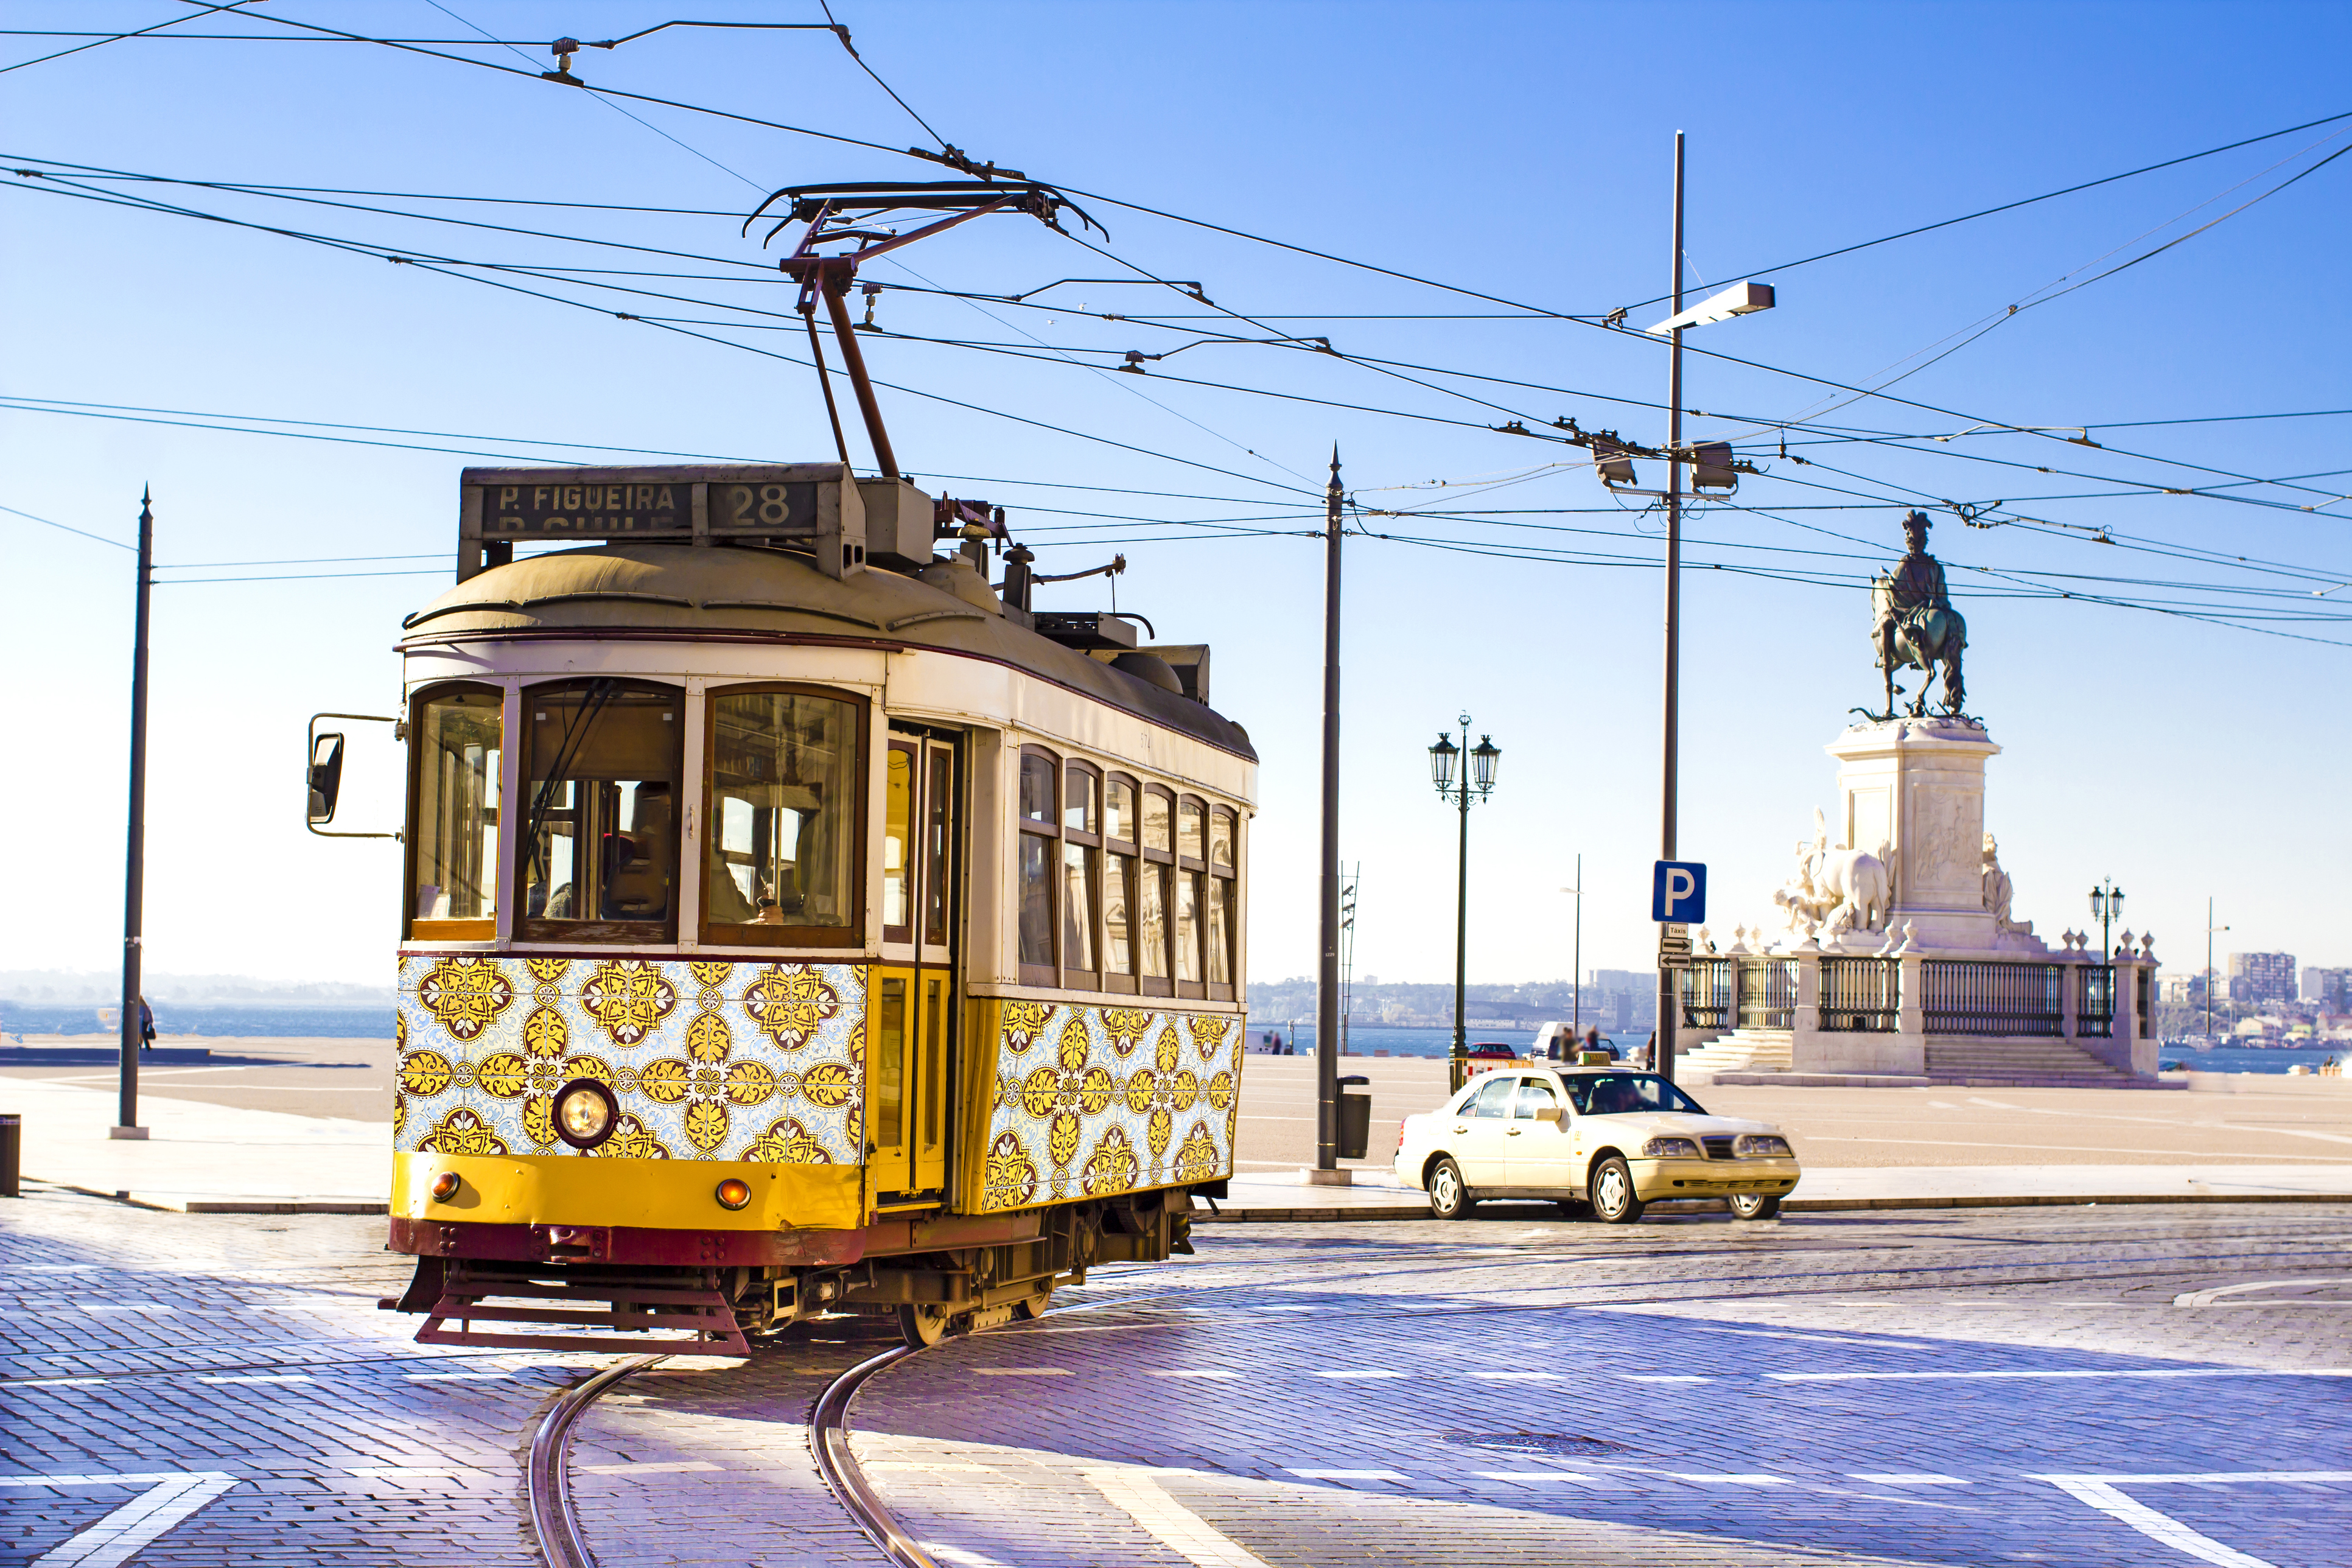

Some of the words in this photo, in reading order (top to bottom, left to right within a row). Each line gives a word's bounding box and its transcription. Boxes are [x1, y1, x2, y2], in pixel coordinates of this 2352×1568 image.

[500, 486, 519, 509] P.
[534, 485, 675, 510] FIGUEIRA
[731, 485, 789, 525] 28
[1141, 732, 1150, 752] 574
[1665, 868, 1695, 916] P
